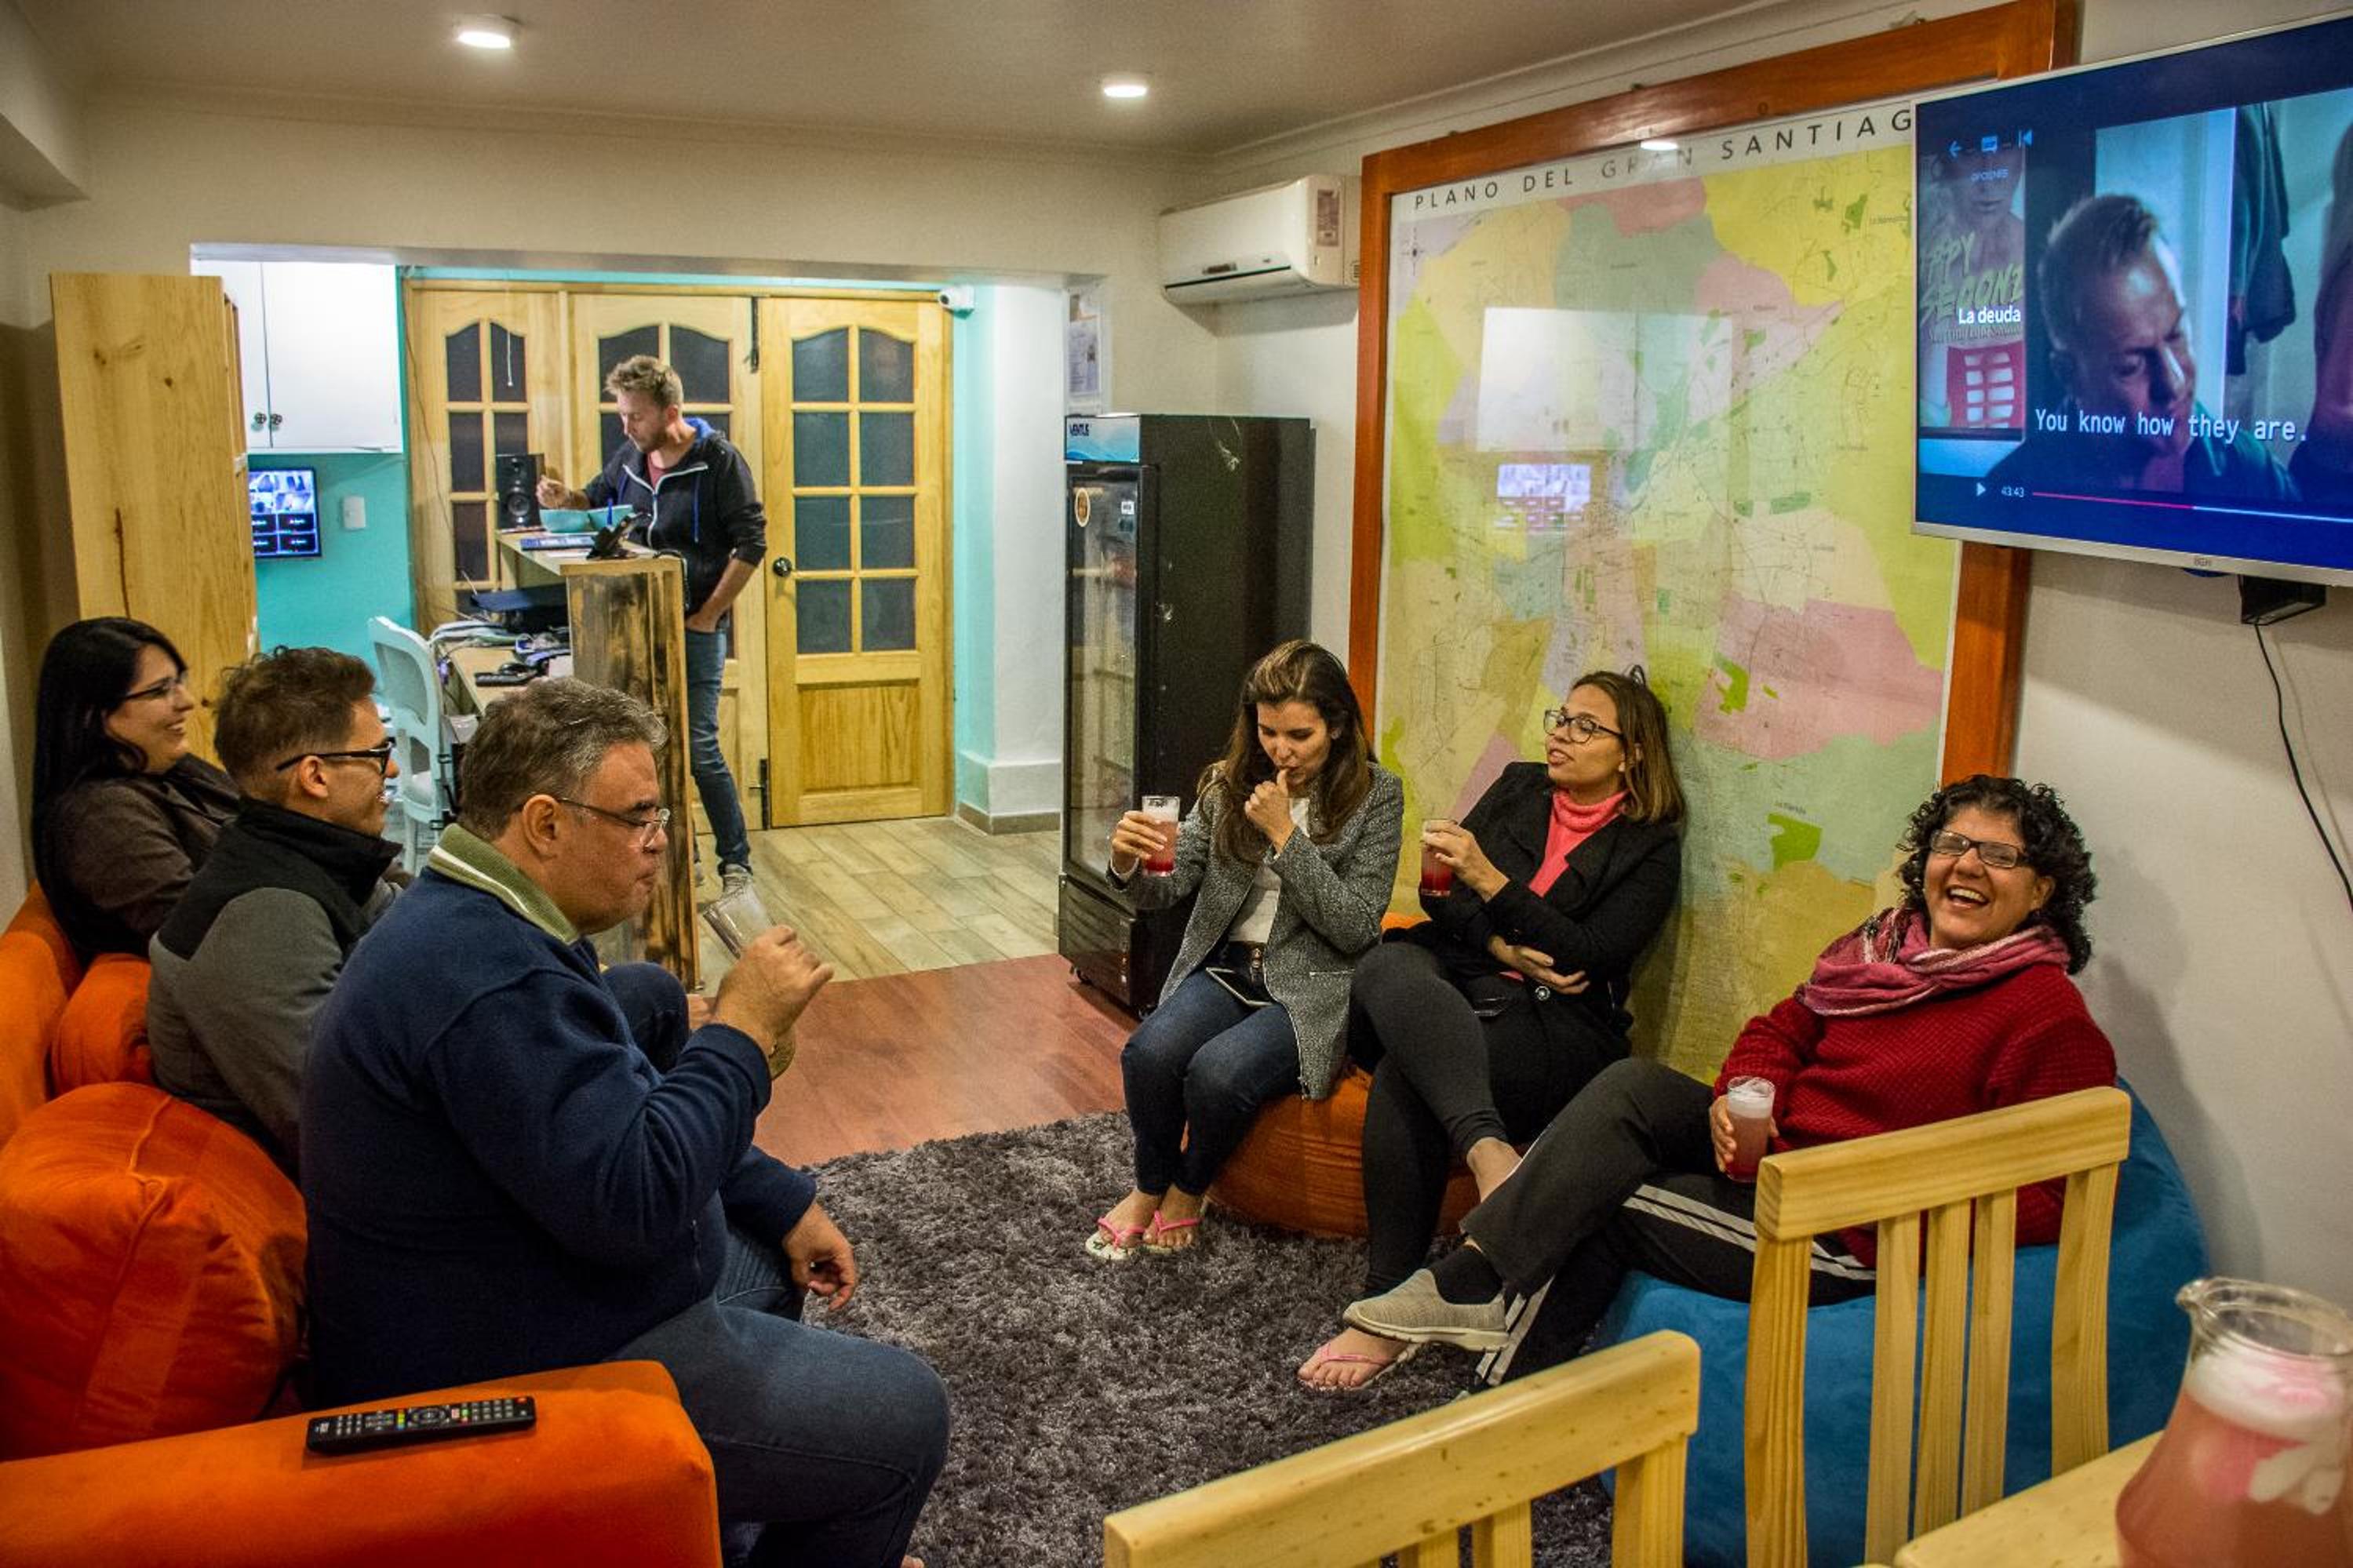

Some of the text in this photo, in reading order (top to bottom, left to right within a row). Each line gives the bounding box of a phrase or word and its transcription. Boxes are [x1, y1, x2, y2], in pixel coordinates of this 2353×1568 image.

[1415, 181, 1499, 209] PLANO
[1523, 167, 1573, 193] DEL
[1958, 304, 2022, 325] La deuda
[2035, 408, 2307, 444] You know how they are.
